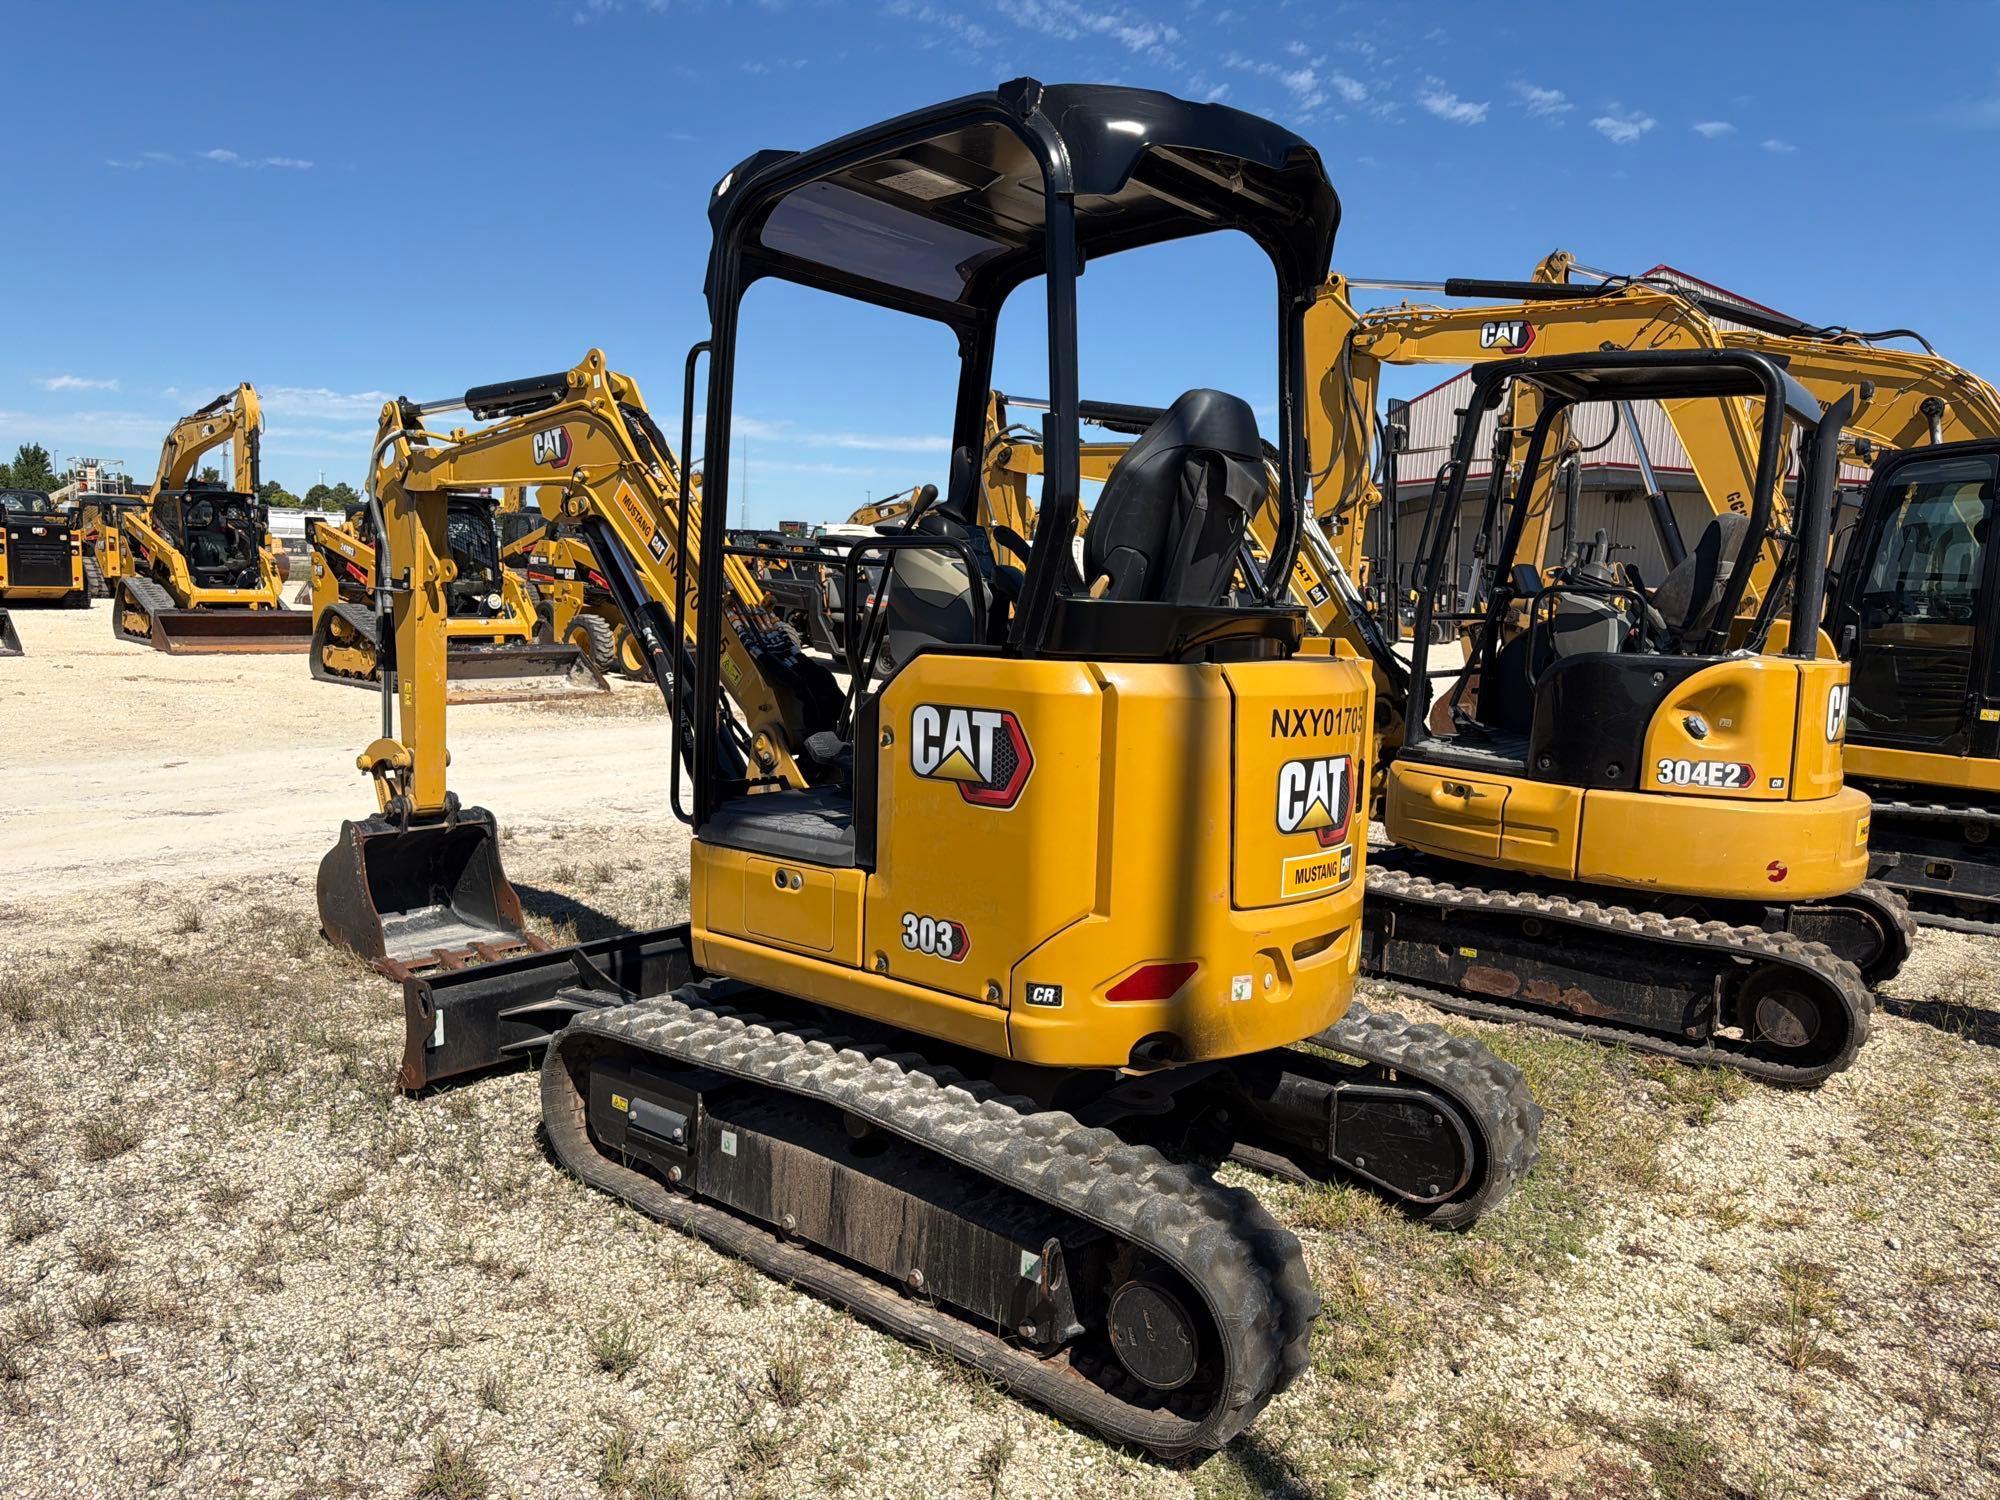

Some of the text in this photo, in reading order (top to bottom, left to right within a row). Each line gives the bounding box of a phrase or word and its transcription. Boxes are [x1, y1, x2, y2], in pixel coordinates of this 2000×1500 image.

[1481, 321, 1524, 348] CAT
[533, 427, 562, 465] CAT
[622, 494, 666, 556] MUSTANG CAT
[1294, 560, 1325, 602] OLT CAT
[1270, 704, 1364, 738] NXY01705
[1827, 685, 1849, 741] CA
[911, 704, 1002, 784] CAT
[1657, 759, 1742, 787] 304E2
[1277, 756, 1346, 832] CAT
[1295, 861, 1338, 885] MUSTANG
[902, 912, 953, 958] 303
[1032, 986, 1056, 1002] CR
